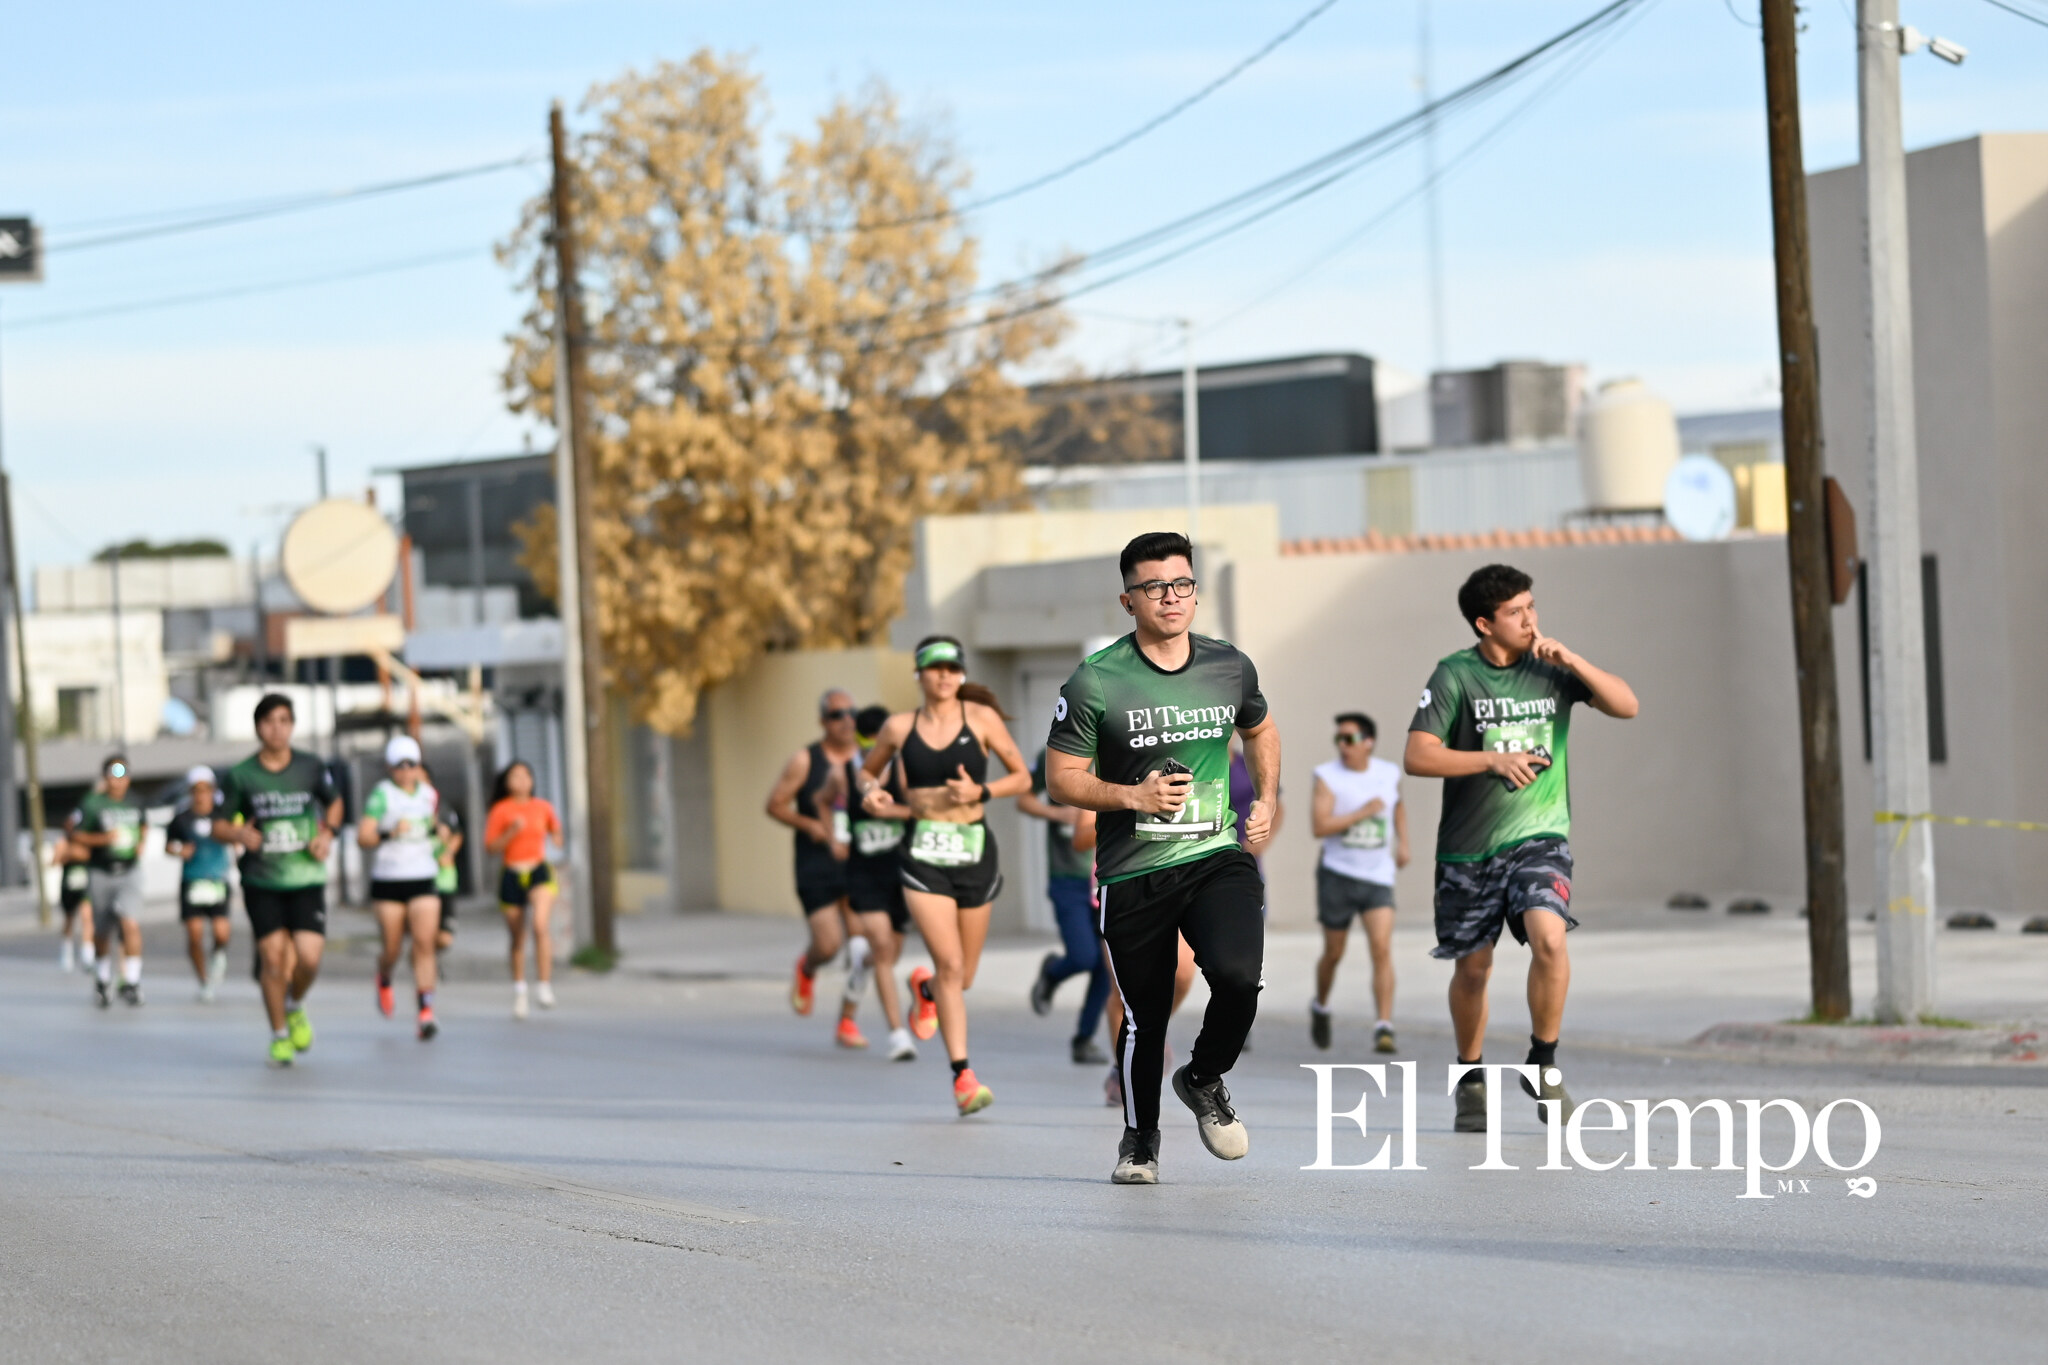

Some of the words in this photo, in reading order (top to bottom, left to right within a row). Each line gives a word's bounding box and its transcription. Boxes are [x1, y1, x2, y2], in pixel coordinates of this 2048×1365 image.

[1125, 707, 1155, 732] El
[1155, 704, 1236, 727] Tiempo
[1475, 698, 1495, 719] El
[1495, 696, 1556, 717] Tiempo
[1129, 734, 1158, 749] de
[1160, 726, 1223, 744] todos
[1215, 792, 1223, 832] MEDALLA
[921, 831, 965, 852] 558
